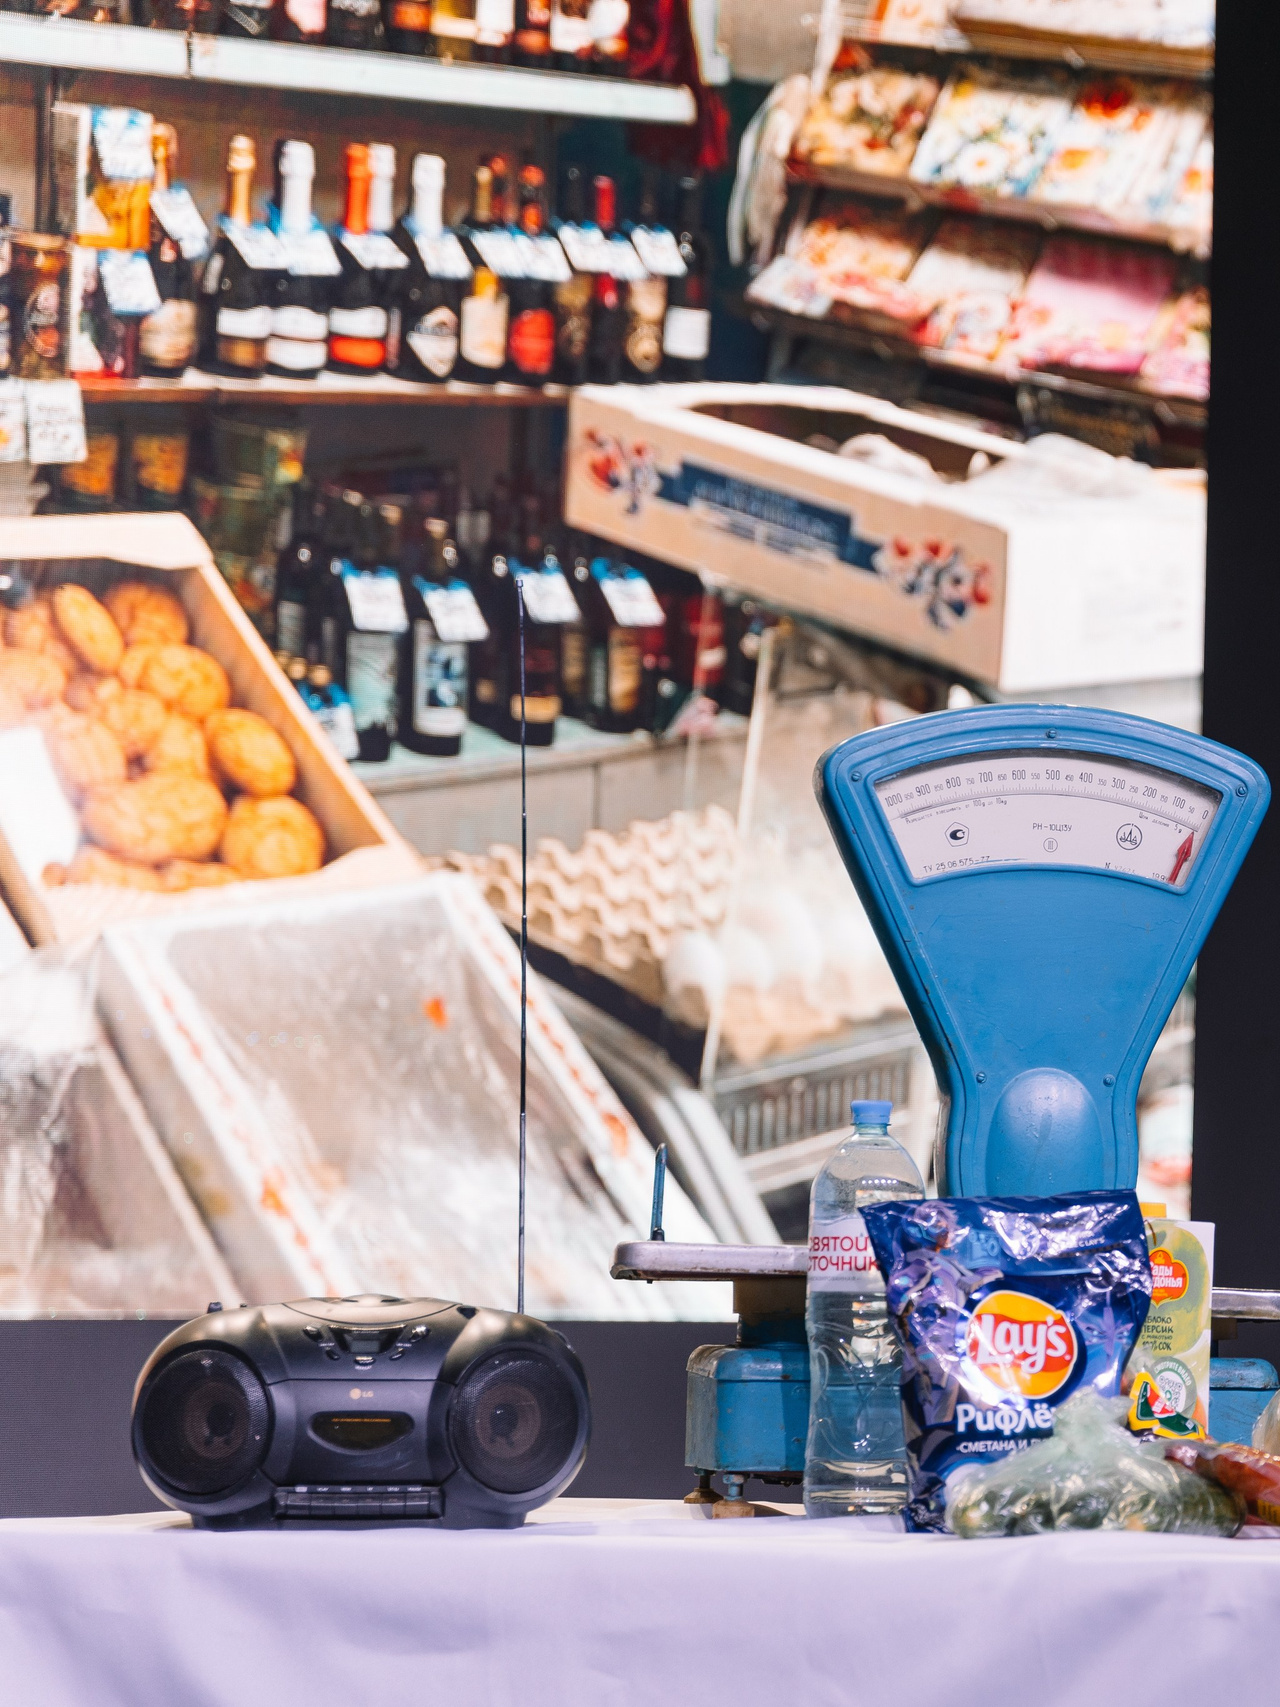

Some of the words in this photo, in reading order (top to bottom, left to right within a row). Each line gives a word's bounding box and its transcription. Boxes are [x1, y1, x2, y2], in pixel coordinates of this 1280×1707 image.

[884, 792, 903, 807] 1000
[904, 792, 914, 801] 950
[915, 783, 931, 797] 900
[934, 783, 944, 792] 850
[945, 776, 962, 789] 800
[965, 777, 975, 785] 750
[978, 771, 994, 783] 700
[997, 773, 1008, 781] 650
[1011, 769, 1027, 780] 600
[1030, 772, 1041, 780] 550
[1045, 769, 1061, 781] 500
[1065, 774, 1075, 782] 450
[1078, 772, 1094, 784] 400
[1097, 778, 1107, 787] 350
[1111, 777, 1126, 790] 300
[1129, 785, 1139, 794] 250
[1142, 785, 1158, 799] 200
[1159, 794, 1169, 803] 150
[1172, 796, 1186, 809] 100
[1188, 805, 1196, 814] 50
[1201, 809, 1209, 820] 0
[1151, 1277, 1183, 1289] донья
[1145, 1315, 1173, 1324] БЛОКО
[976, 1313, 1068, 1374] Lay's
[1158, 1341, 1172, 1351] СОК
[361, 1390, 374, 1398] LG
[960, 1439, 1016, 1454] СМЕТАНА
